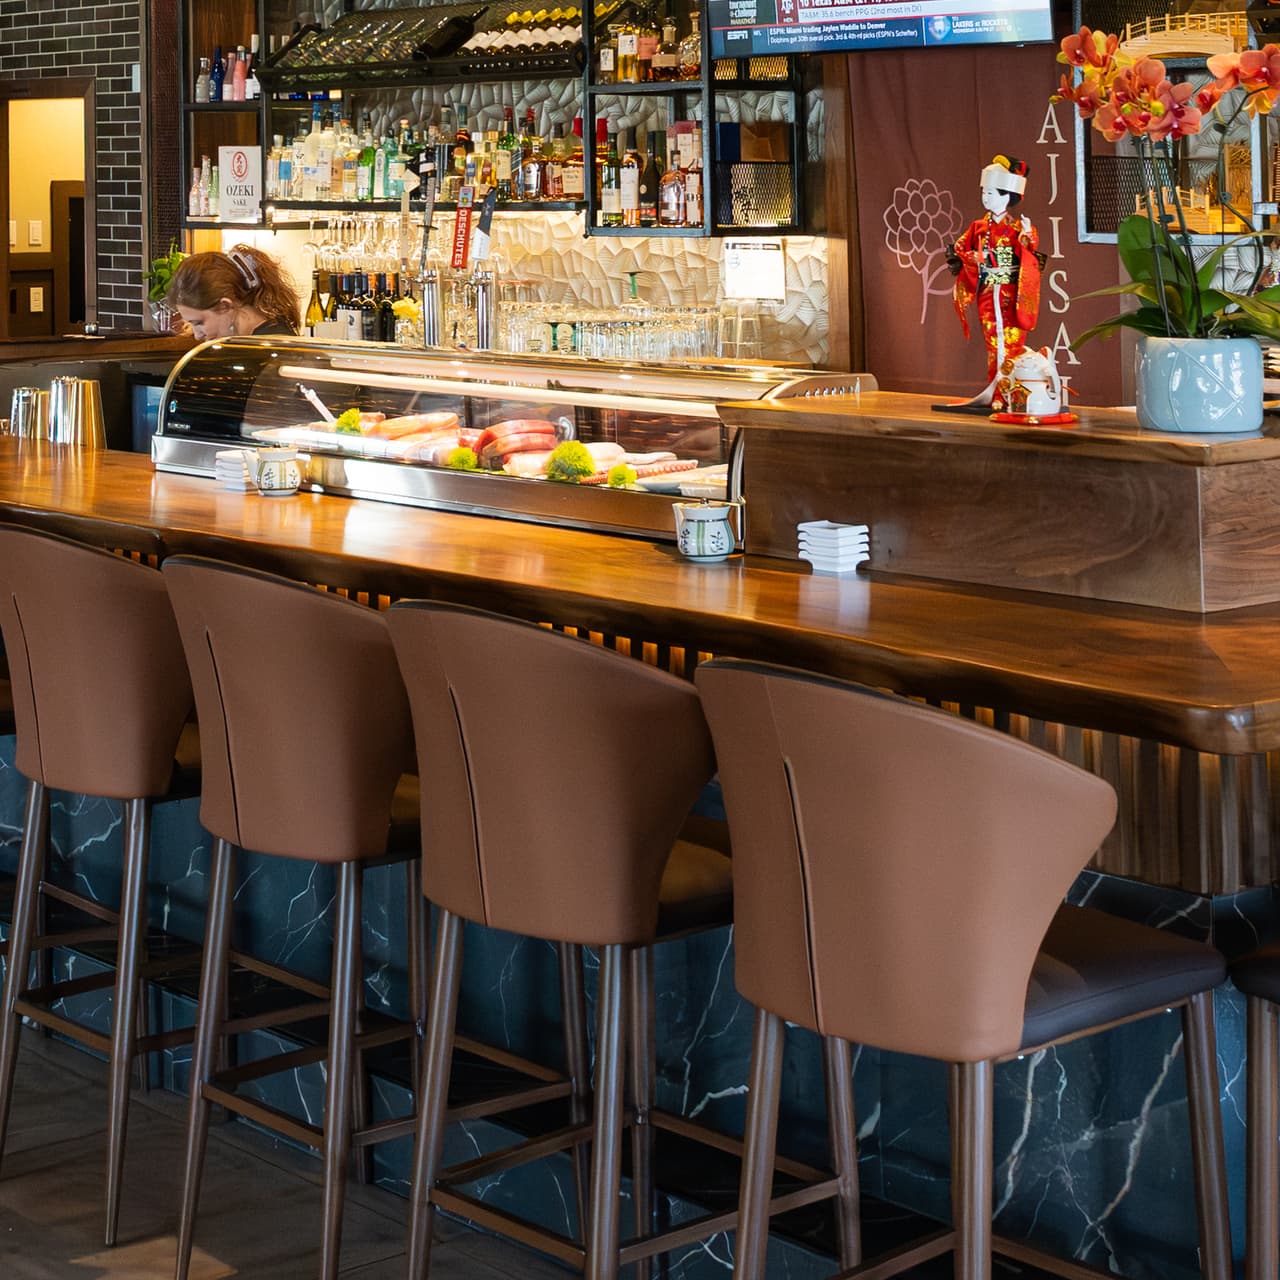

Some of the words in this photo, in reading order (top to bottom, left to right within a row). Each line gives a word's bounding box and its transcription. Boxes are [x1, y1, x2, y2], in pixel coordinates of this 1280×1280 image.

[727, 30, 749, 40] ESPN
[226, 184, 254, 197] OZEKI
[454, 209, 468, 266] DESCHUTES
[1036, 102, 1081, 407] AJISAI
